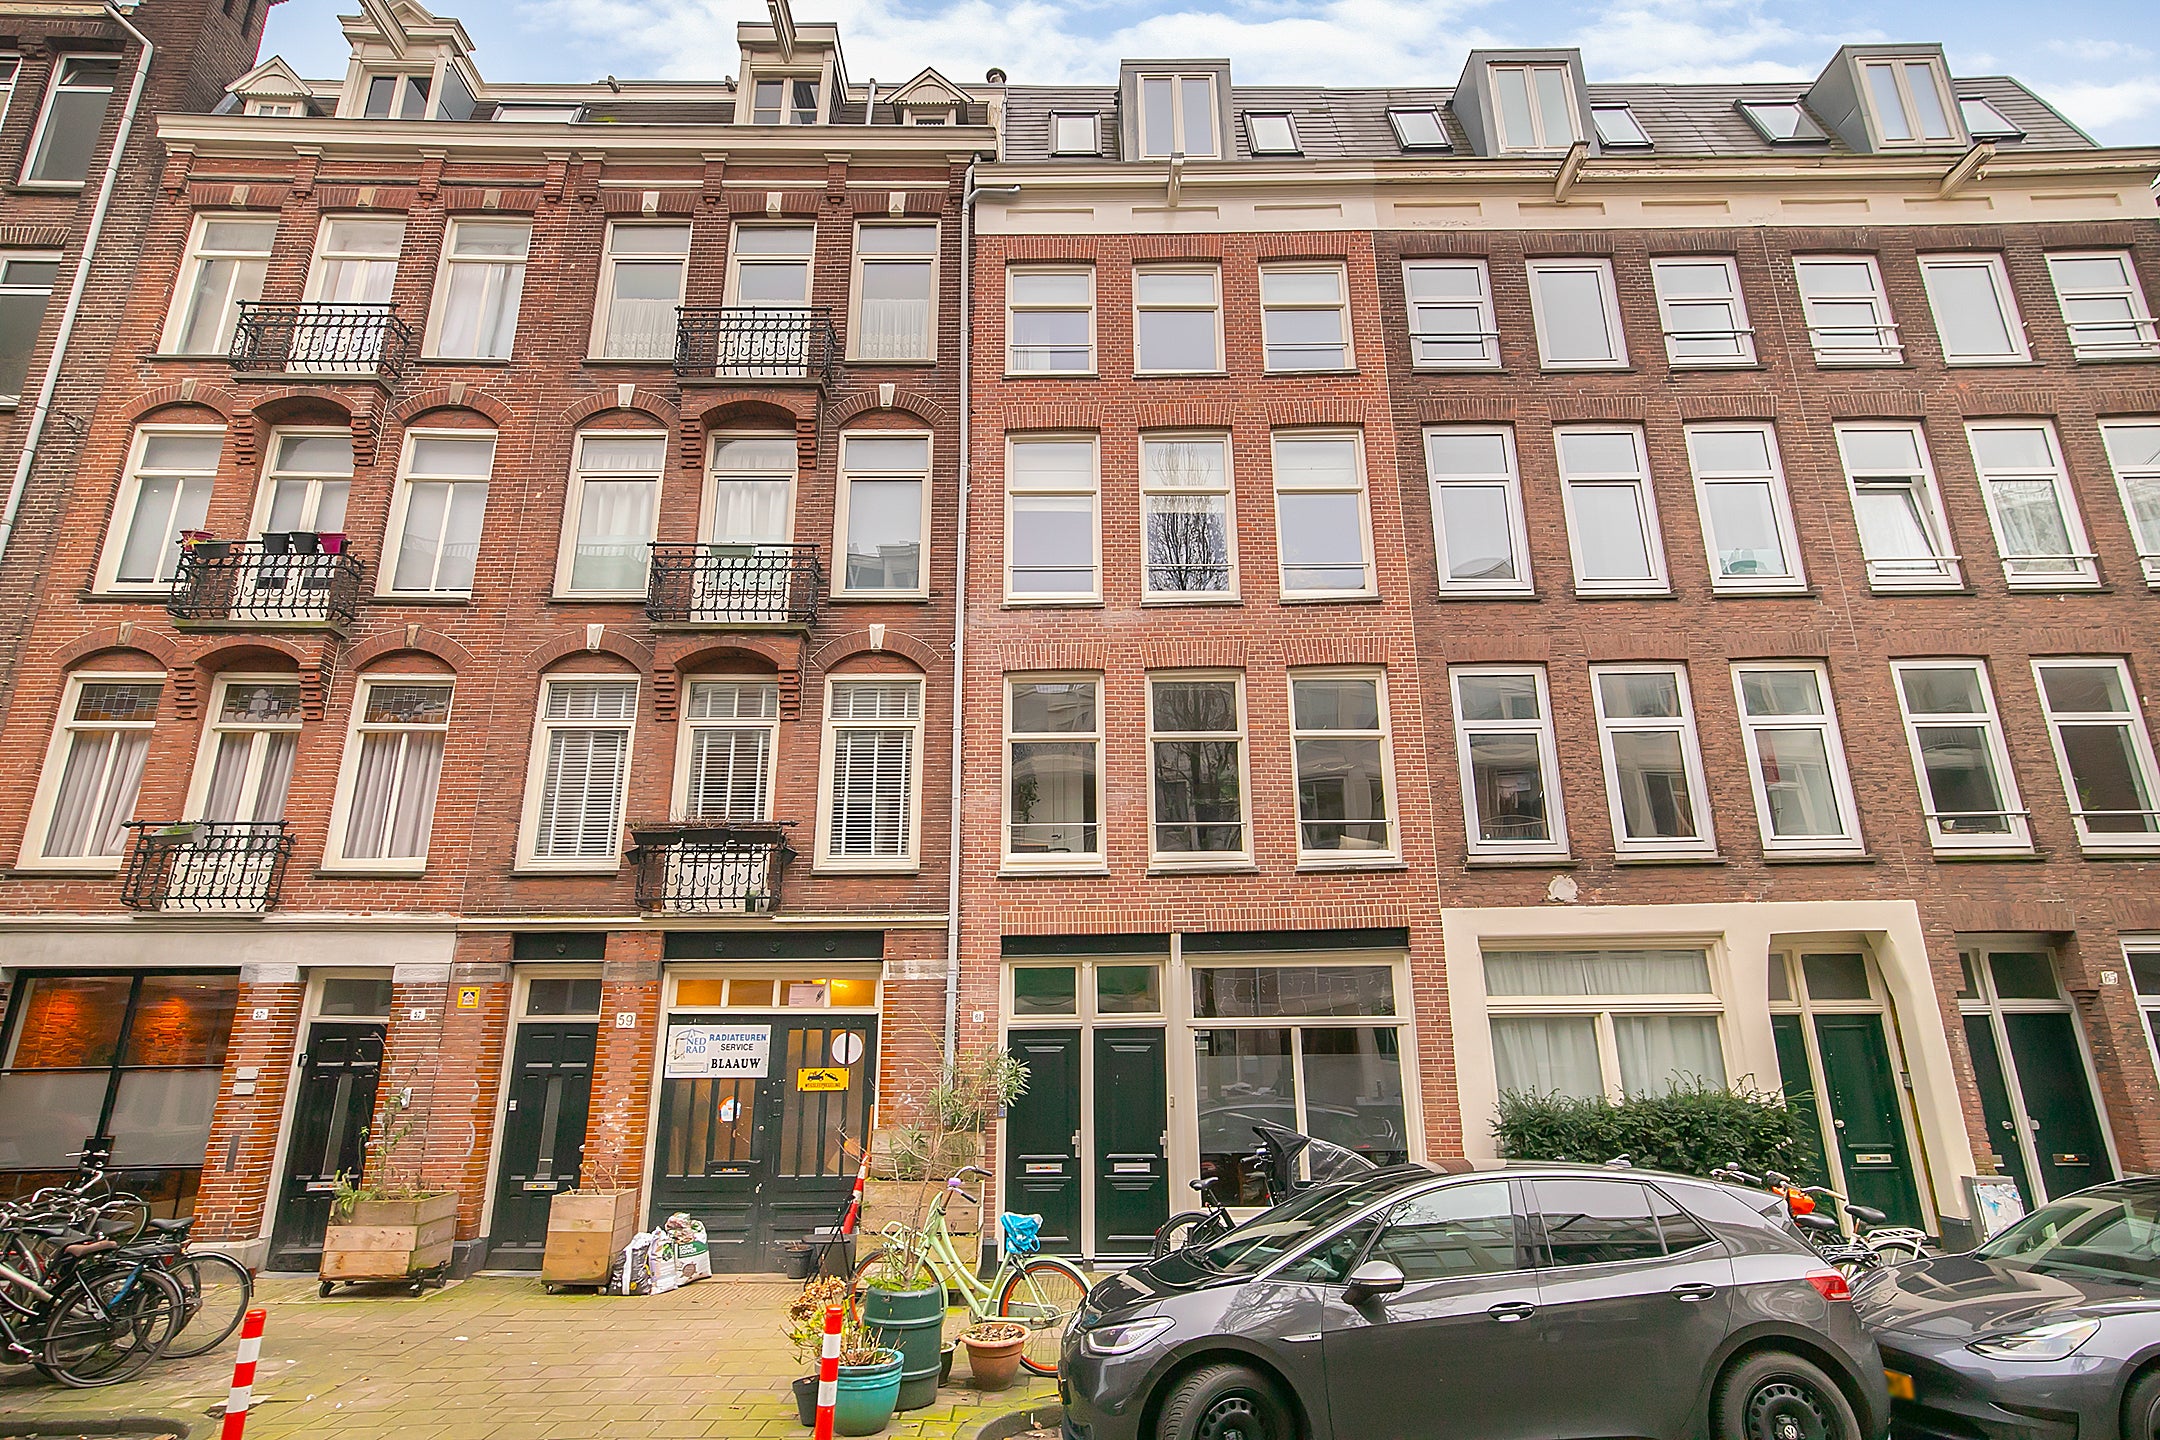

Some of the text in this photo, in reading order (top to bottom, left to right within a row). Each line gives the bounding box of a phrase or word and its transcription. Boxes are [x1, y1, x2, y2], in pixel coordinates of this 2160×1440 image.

[618, 1014, 634, 1026] 59
[709, 1033, 767, 1041] RADIATEUREN
[687, 1037, 707, 1046] NED
[686, 1045, 706, 1053] RAD
[720, 1043, 754, 1051] SERVICE
[711, 1058, 761, 1069] BLAAUW
